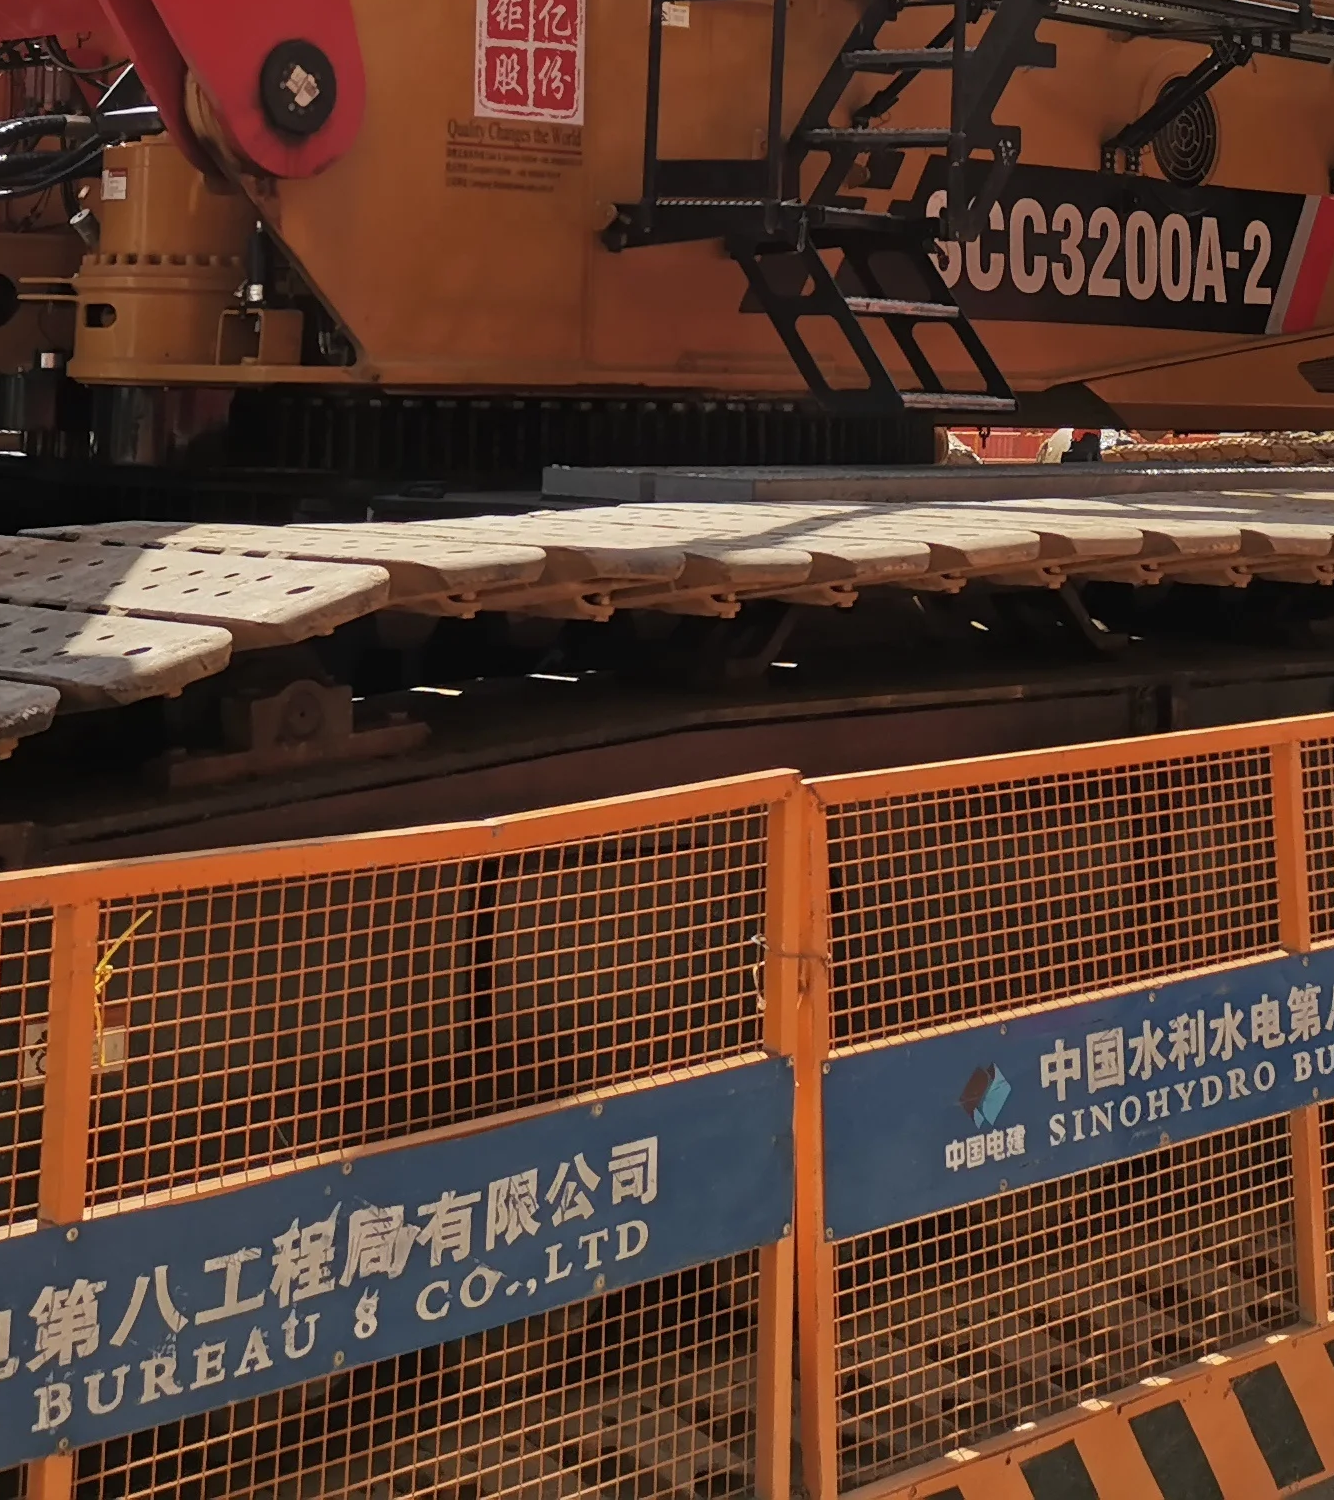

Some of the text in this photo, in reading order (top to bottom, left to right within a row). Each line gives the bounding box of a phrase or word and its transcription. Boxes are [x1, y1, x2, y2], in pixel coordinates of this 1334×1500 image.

[448, 118, 582, 147] Quality Changes the World
[1048, 1060, 1277, 1148] SINOHYDRO
[945, 1124, 1027, 1173] 中国电建
[32, 1302, 320, 1433] BUREAU
[416, 1218, 650, 1322] CO.,LTD
